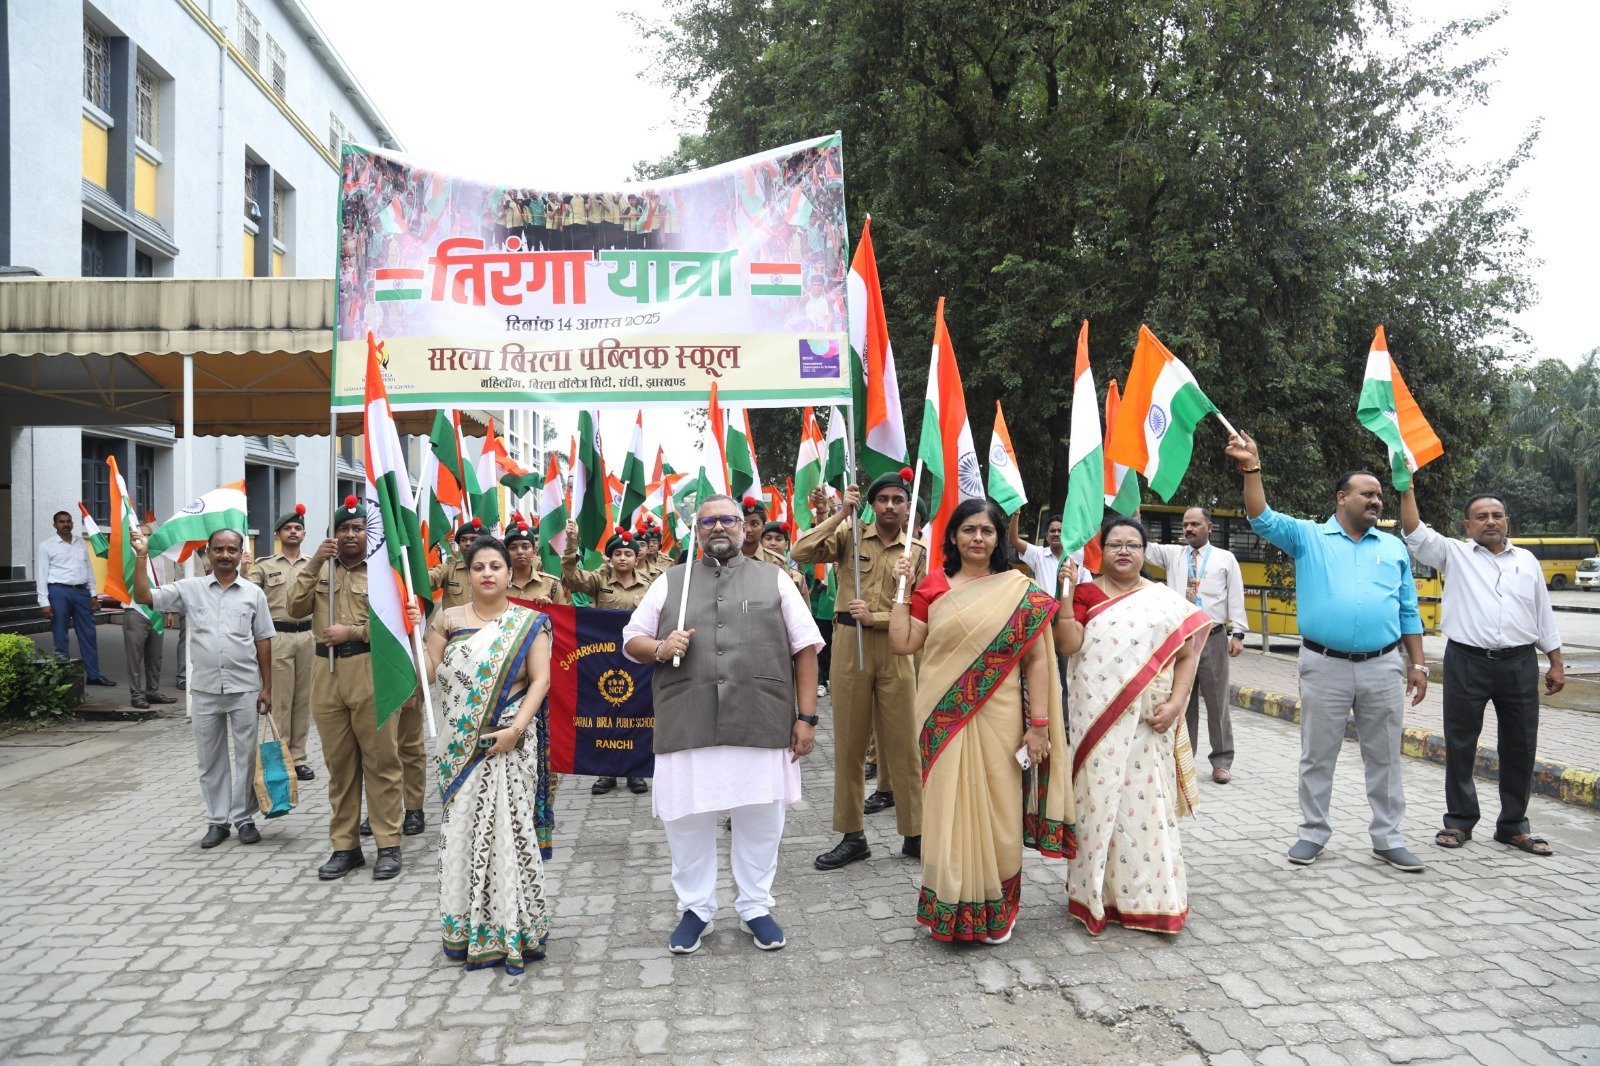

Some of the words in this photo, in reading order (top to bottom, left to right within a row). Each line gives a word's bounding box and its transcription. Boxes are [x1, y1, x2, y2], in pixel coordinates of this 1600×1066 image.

[429, 236, 593, 306] तिरंगा
[600, 248, 738, 303] यात्रा
[505, 314, 555, 331] दिनांक
[558, 318, 572, 331] 14
[576, 317, 622, 330] अगस्त
[625, 312, 661, 326] 2025
[428, 347, 494, 371] सरला
[499, 342, 573, 373] बिरला
[578, 338, 670, 370] पब्लिक
[675, 345, 741, 377] स्कूल
[529, 378, 556, 390] बिरला
[560, 660, 569, 671] 3
[567, 642, 616, 664] JHARKHAND
[608, 686, 624, 694] NCC
[573, 716, 593, 728] SARALA
[597, 716, 612, 728] BIRLA
[616, 716, 635, 728] PUBLIC
[635, 716, 656, 728] SCHOO
[596, 739, 633, 750] RANCHI
